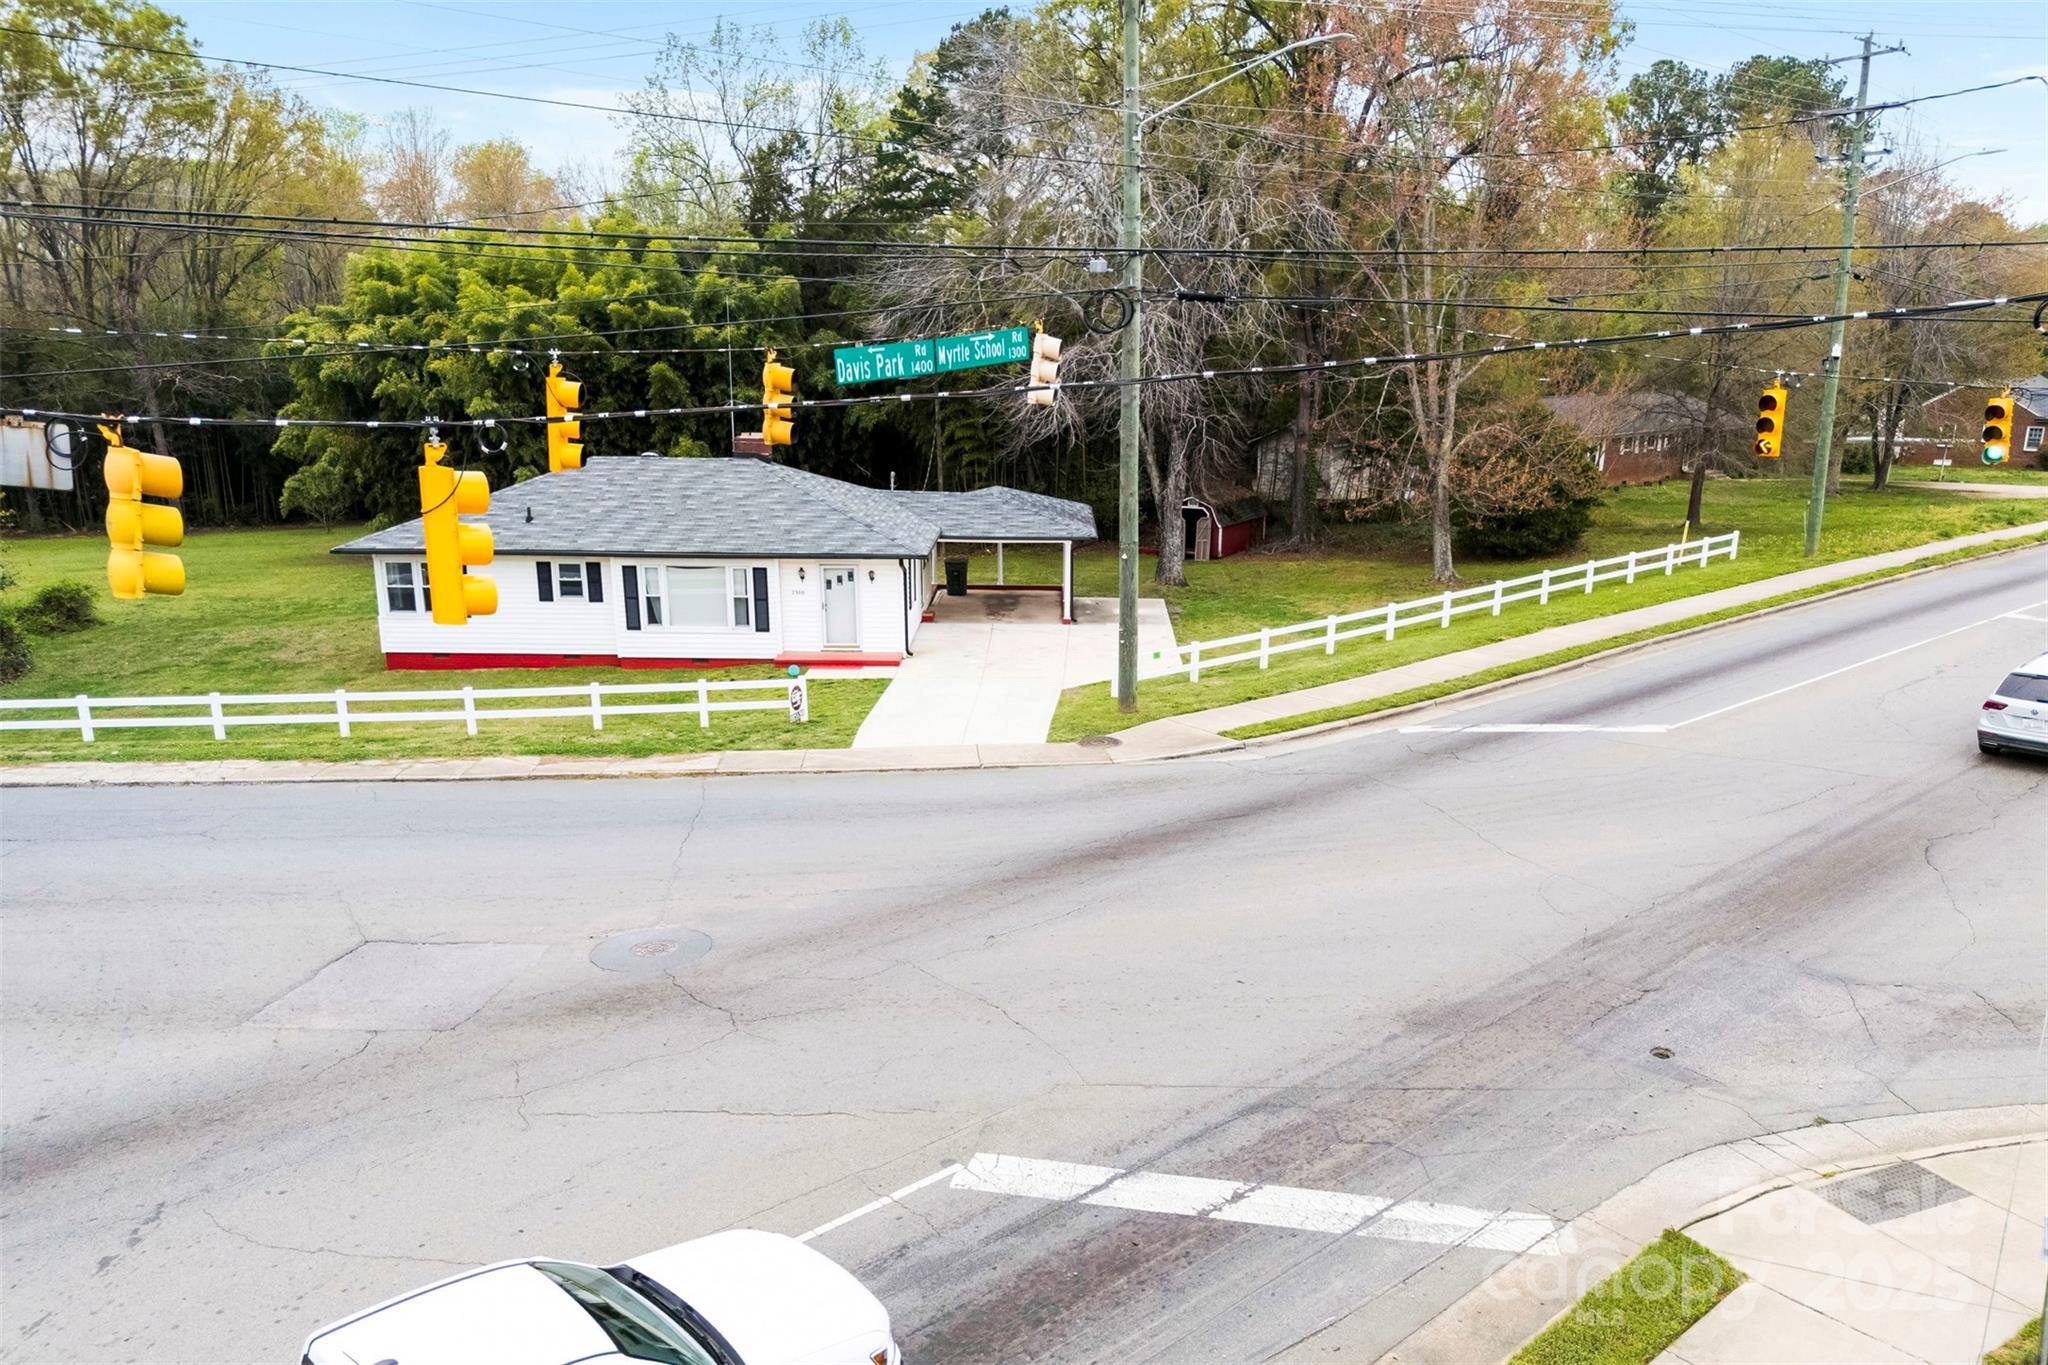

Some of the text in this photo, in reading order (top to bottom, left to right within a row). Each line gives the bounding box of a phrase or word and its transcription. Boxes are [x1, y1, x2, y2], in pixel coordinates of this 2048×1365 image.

[837, 343, 927, 384] Davis Park Rd
[938, 331, 1024, 369] Myrtle School Rd
[1008, 344, 1027, 360] 1300
[911, 359, 934, 374] 1400
